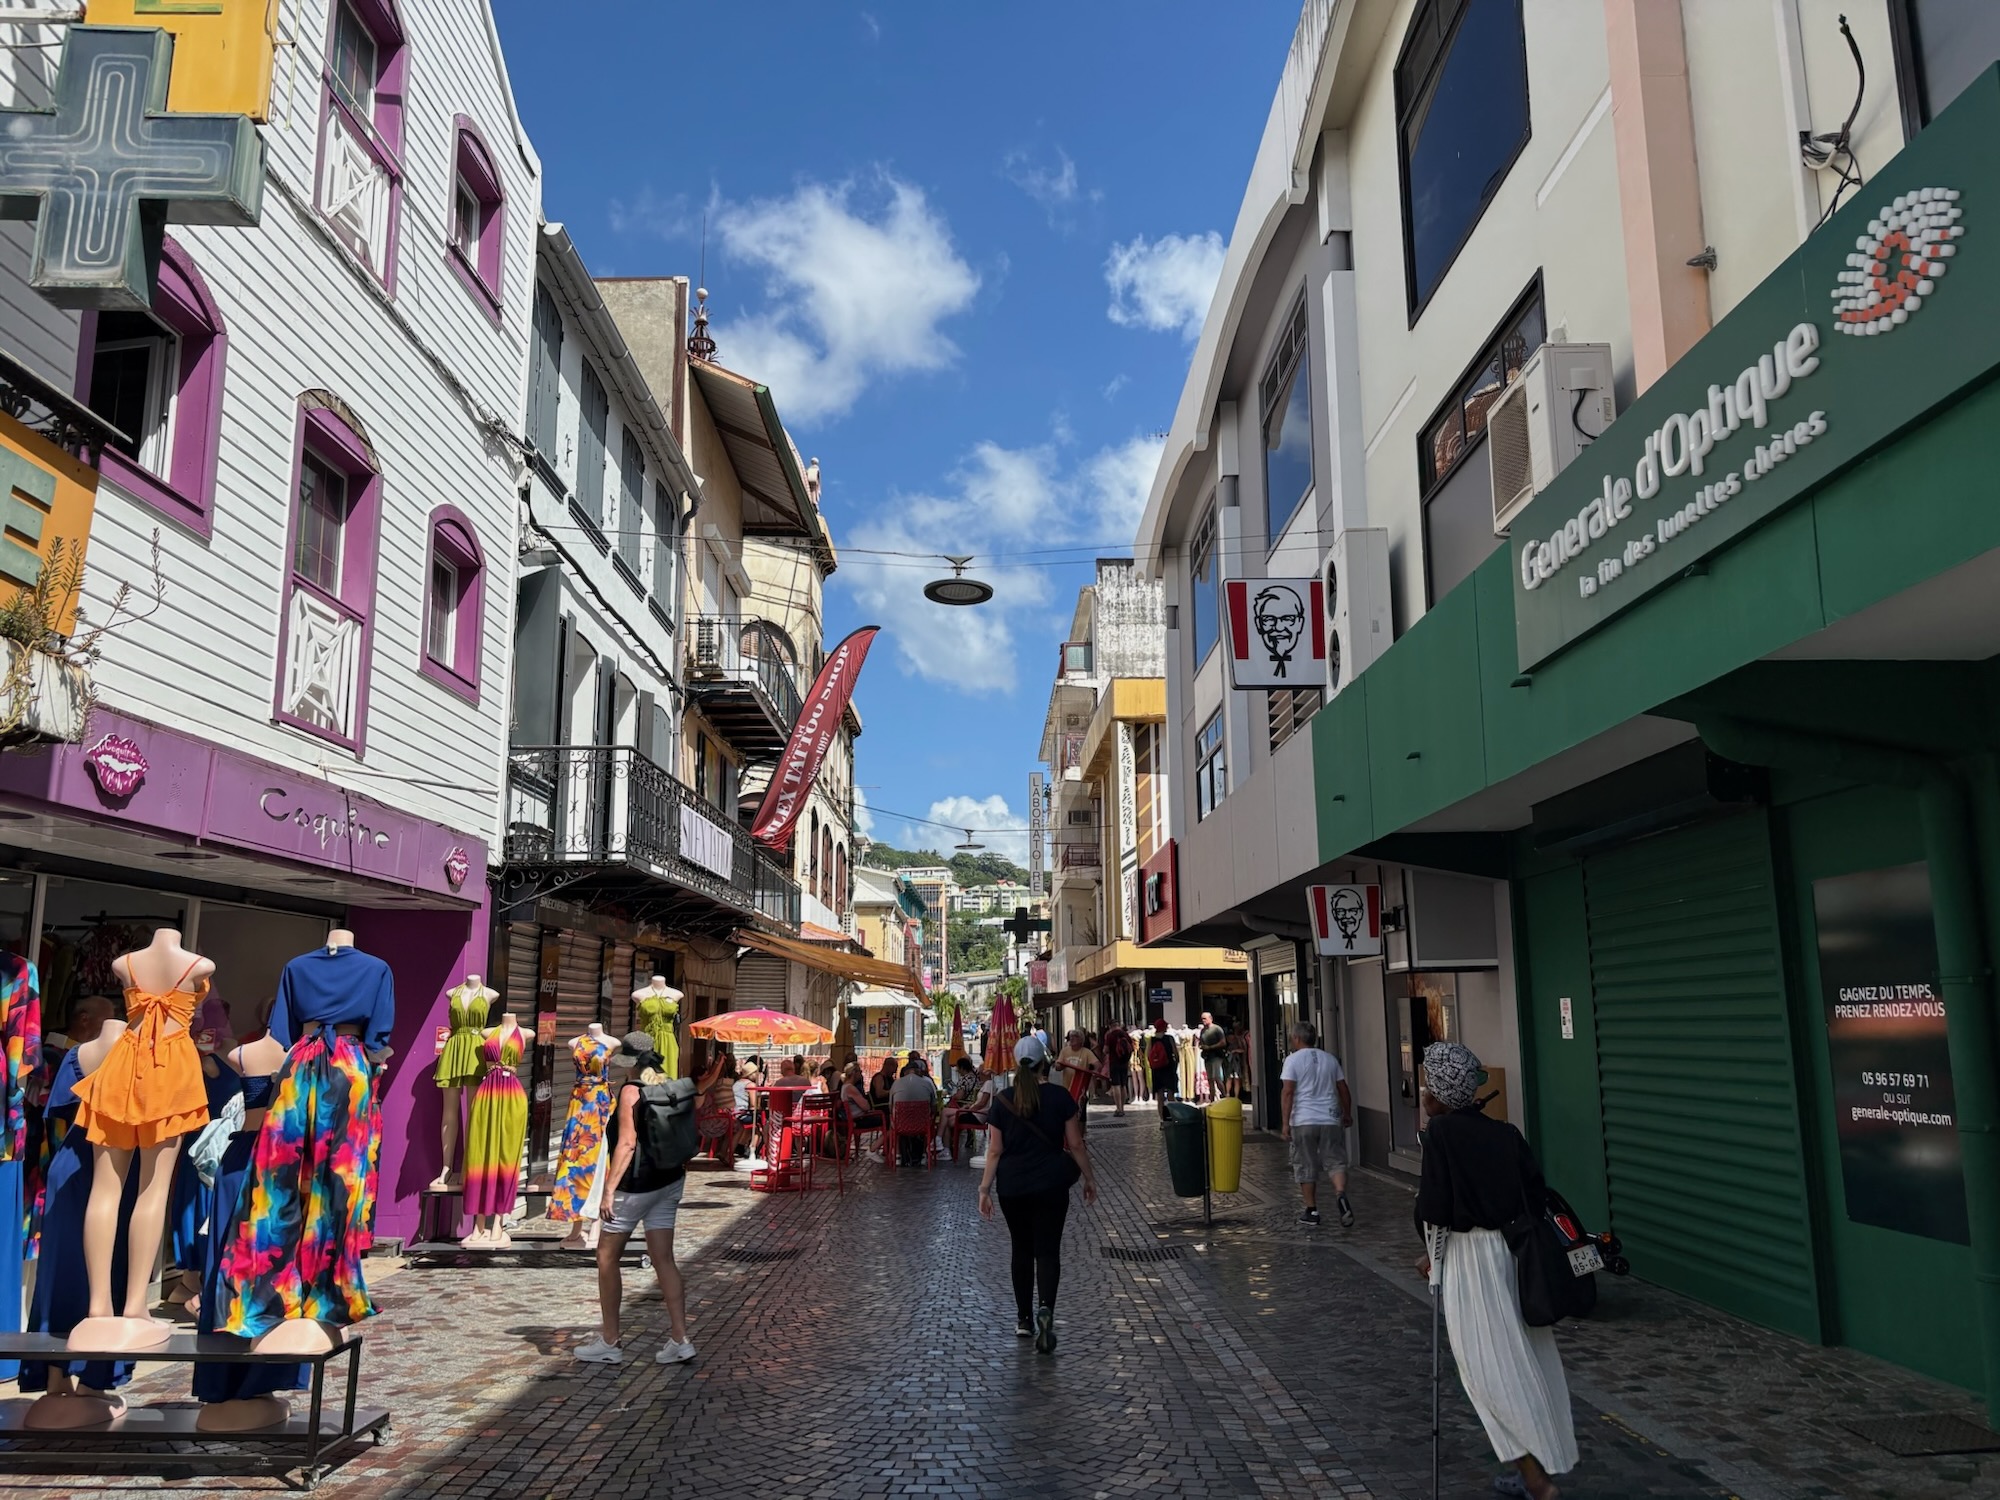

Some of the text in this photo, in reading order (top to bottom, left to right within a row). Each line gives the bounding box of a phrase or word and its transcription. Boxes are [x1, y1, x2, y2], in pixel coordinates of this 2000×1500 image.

[1521, 322, 1820, 590] Generale d'Optique
[1579, 410, 1828, 598] la fin des lunettes chères
[783, 702, 825, 785] TATTOO
[821, 644, 850, 701] SHOP
[104, 739, 137, 759] Coquine
[816, 730, 831, 755] 1997
[259, 787, 391, 851] Coquine
[1032, 777, 1041, 892] LABORATOIRE
[1839, 983, 1935, 1002] GAGNEZ DU TEMPS,
[1834, 1001, 1946, 1018] PRENEZ RENDEZ-VOUS
[1861, 1071, 1929, 1089] 05 96 57 69 71
[1883, 1092, 1911, 1105] ou sur
[1851, 1105, 1952, 1127] generale-optique.com
